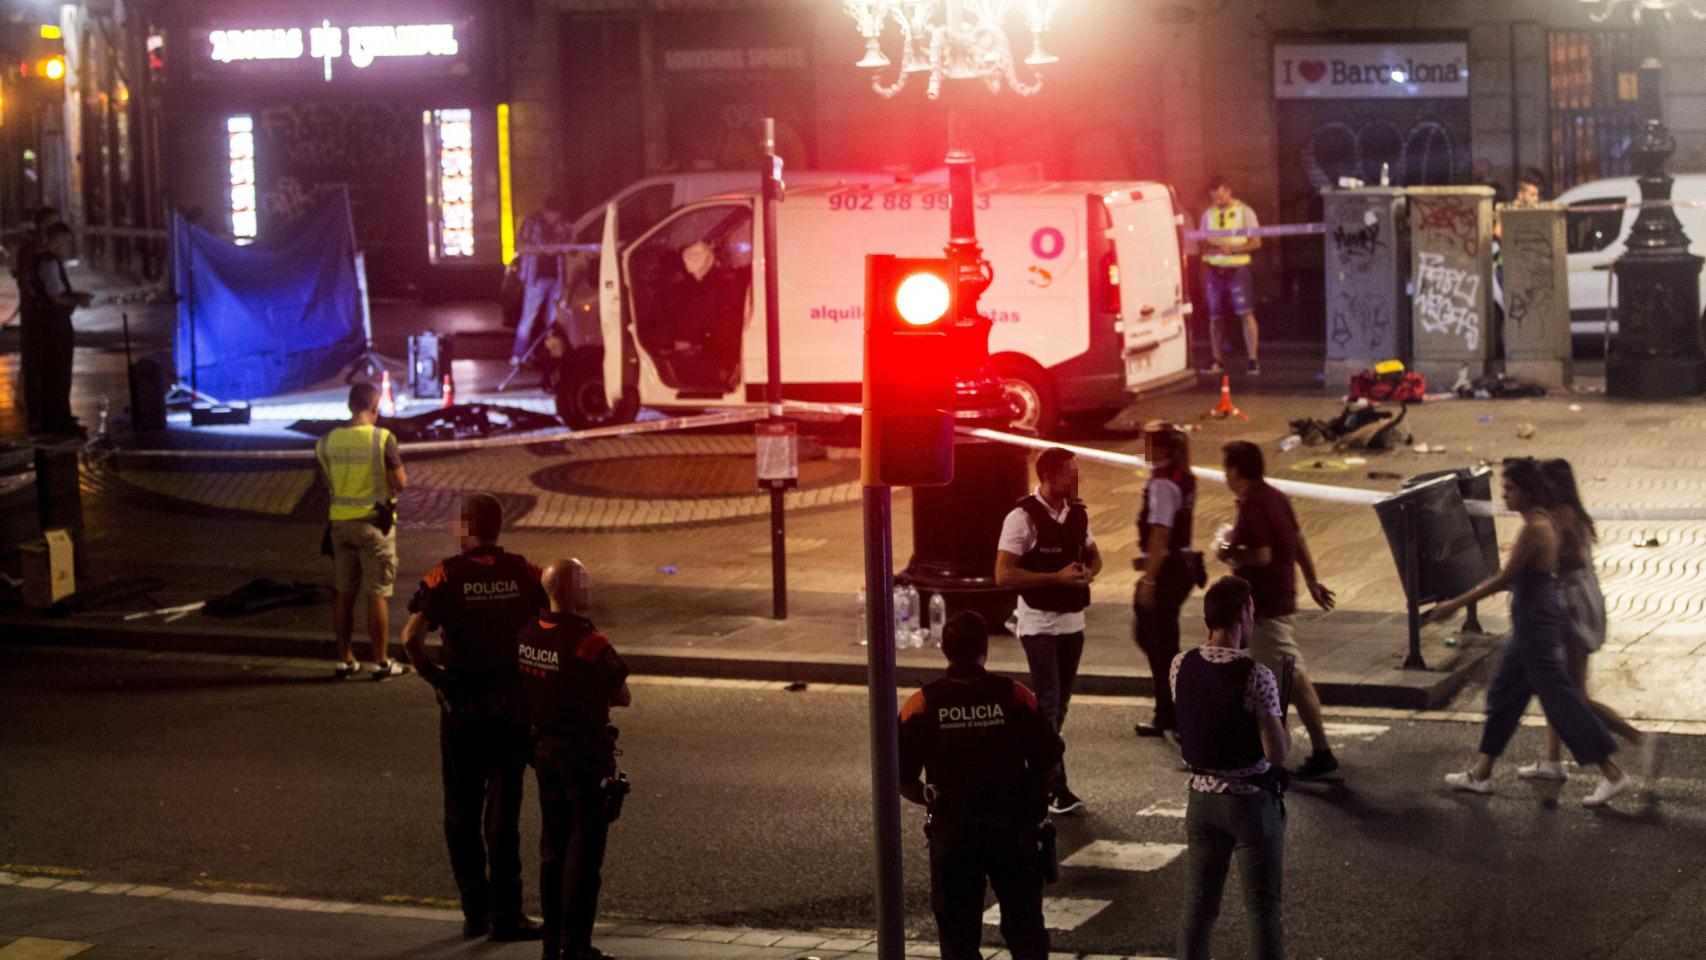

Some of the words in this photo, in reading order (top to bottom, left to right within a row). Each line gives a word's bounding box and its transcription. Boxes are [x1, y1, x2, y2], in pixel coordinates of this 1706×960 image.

[1283, 59, 1294, 85] I
[829, 193, 873, 211] 902
[883, 193, 912, 211] 88
[810, 305, 864, 323] alquil
[464, 581, 519, 595] POLICIA
[519, 644, 559, 664] POLICIA
[938, 704, 1004, 722] POLICIA
